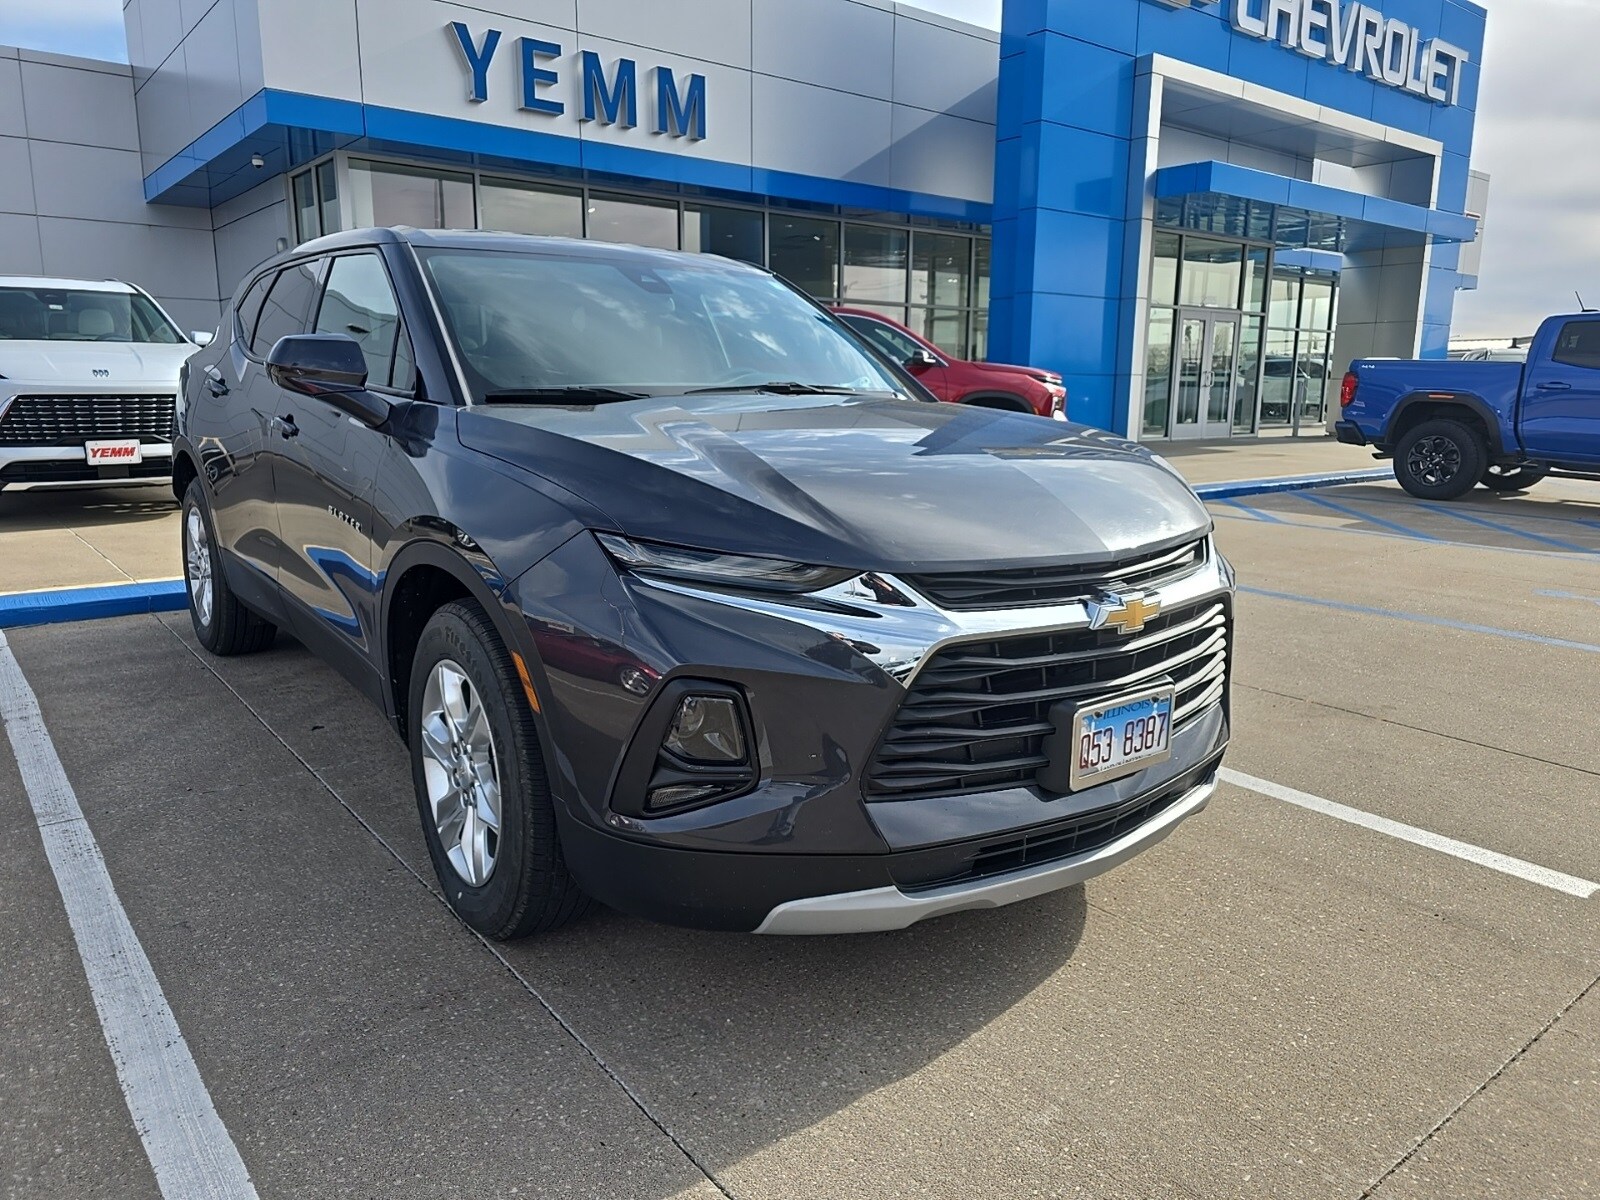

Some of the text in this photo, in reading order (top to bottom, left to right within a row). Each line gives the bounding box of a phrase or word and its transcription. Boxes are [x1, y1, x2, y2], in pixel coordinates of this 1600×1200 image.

[449, 21, 706, 140] YEMM
[90, 446, 136, 458] YEMM
[328, 504, 361, 533] BLAZER
[1103, 699, 1151, 720] ILLINOIS
[1079, 727, 1113, 770] Q53
[1123, 711, 1168, 756] 8387
